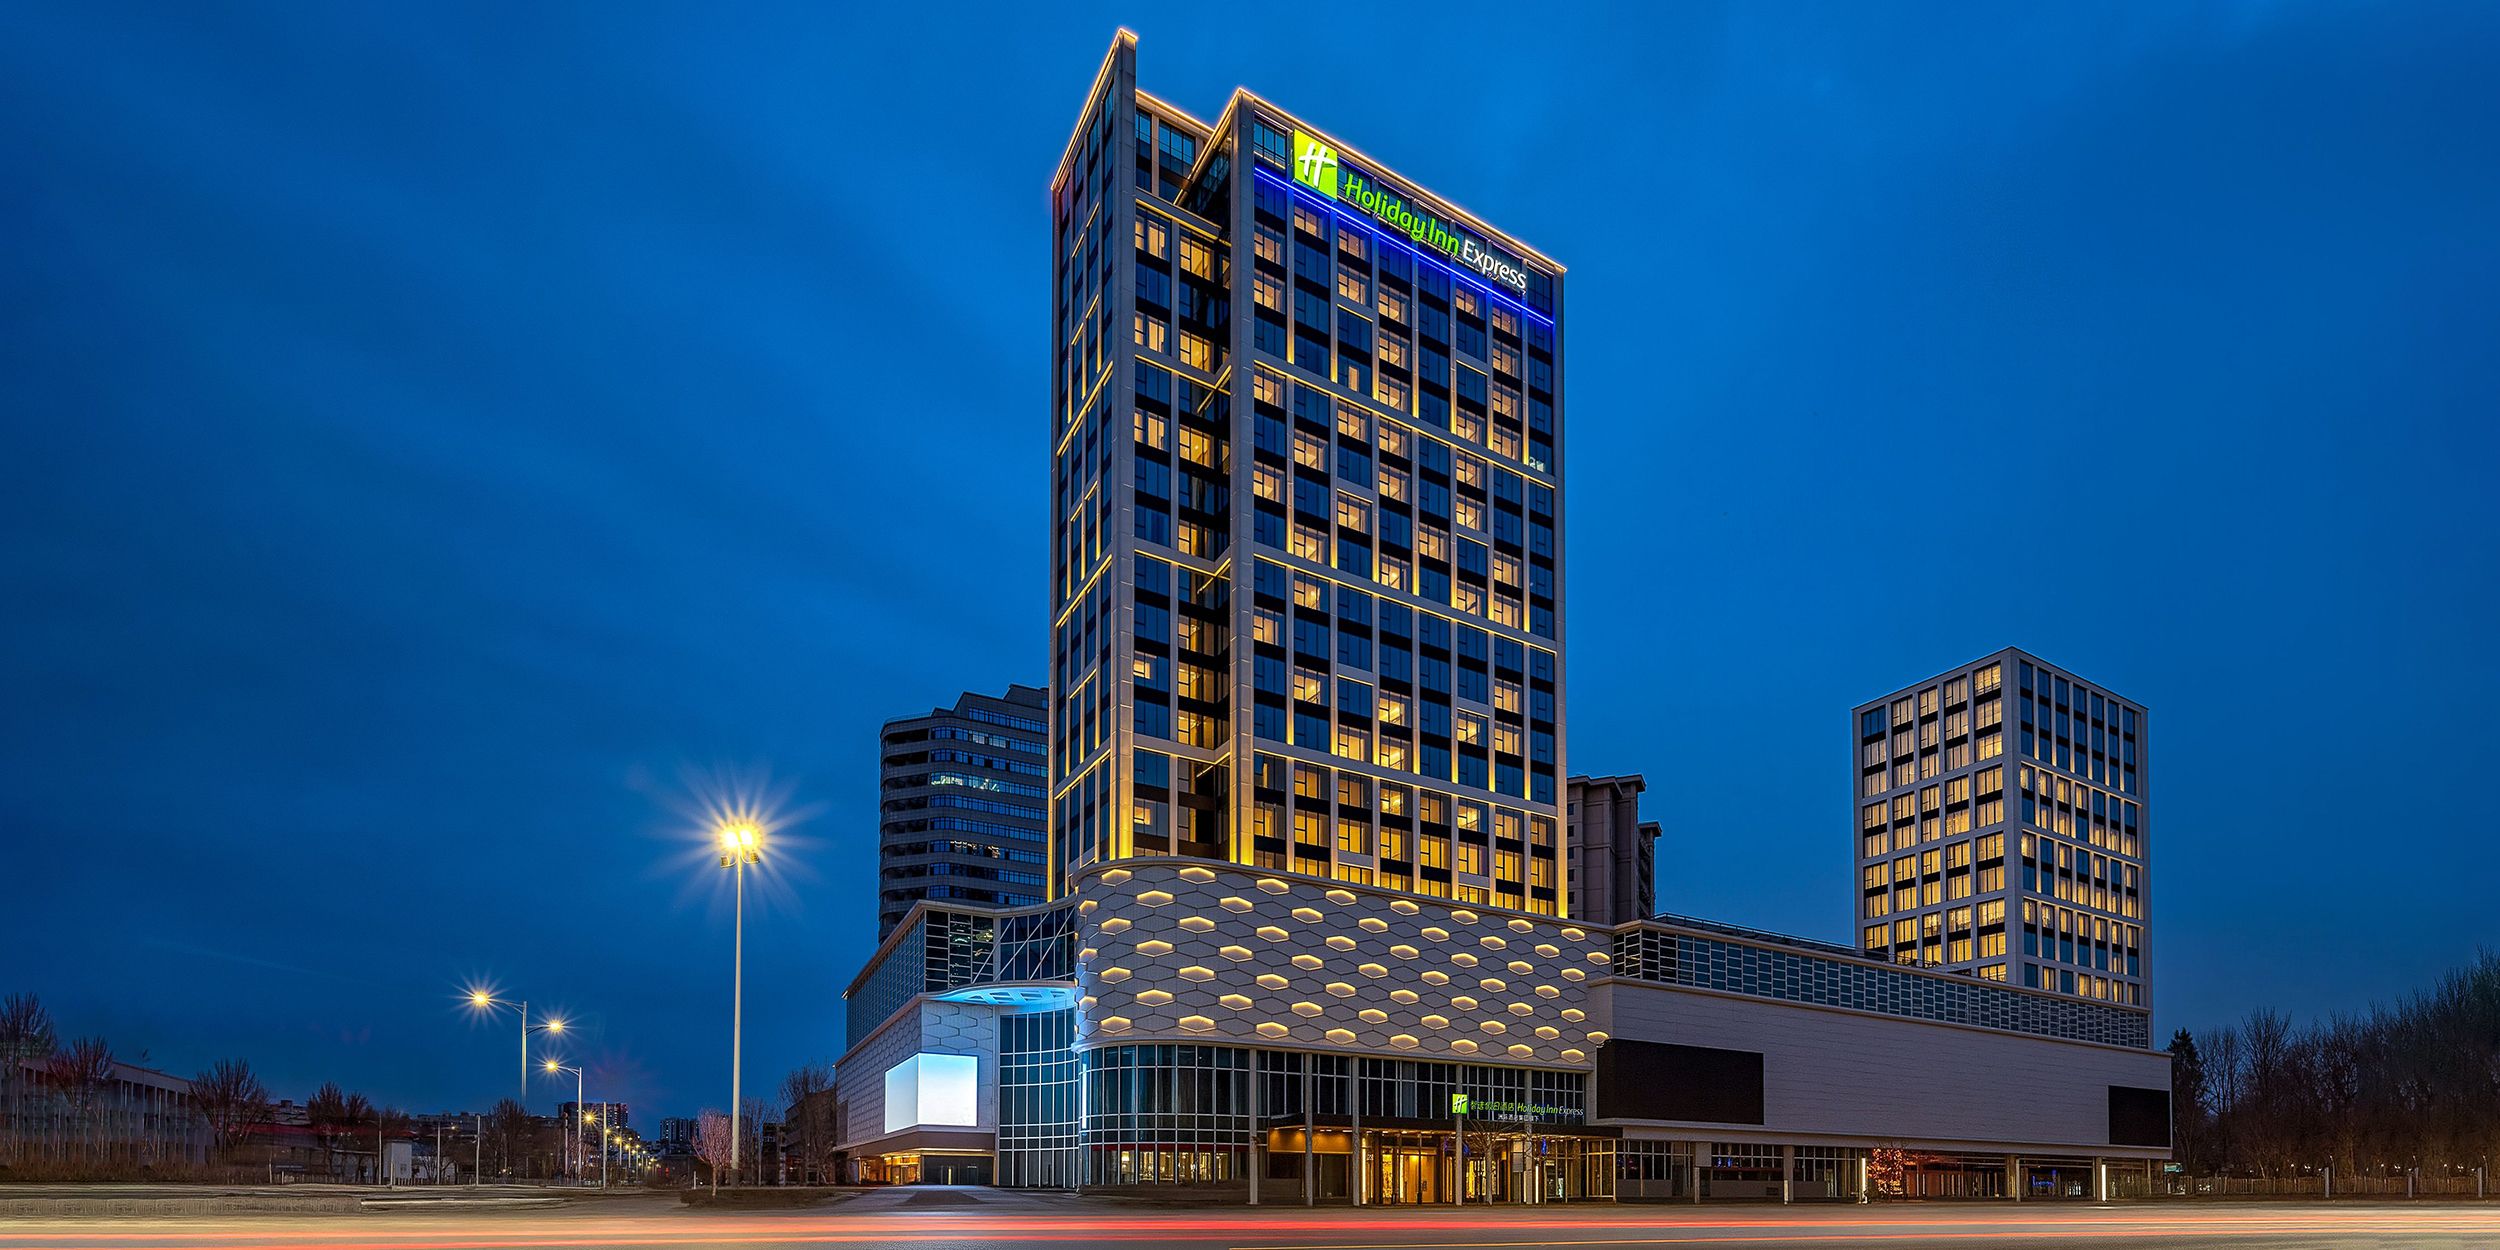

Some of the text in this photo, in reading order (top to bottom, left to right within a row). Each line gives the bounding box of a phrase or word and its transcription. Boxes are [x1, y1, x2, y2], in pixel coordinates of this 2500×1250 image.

[1344, 173, 1527, 289] Holiday Inn Express
[1517, 1102, 1584, 1117] Holiday Inn Express
